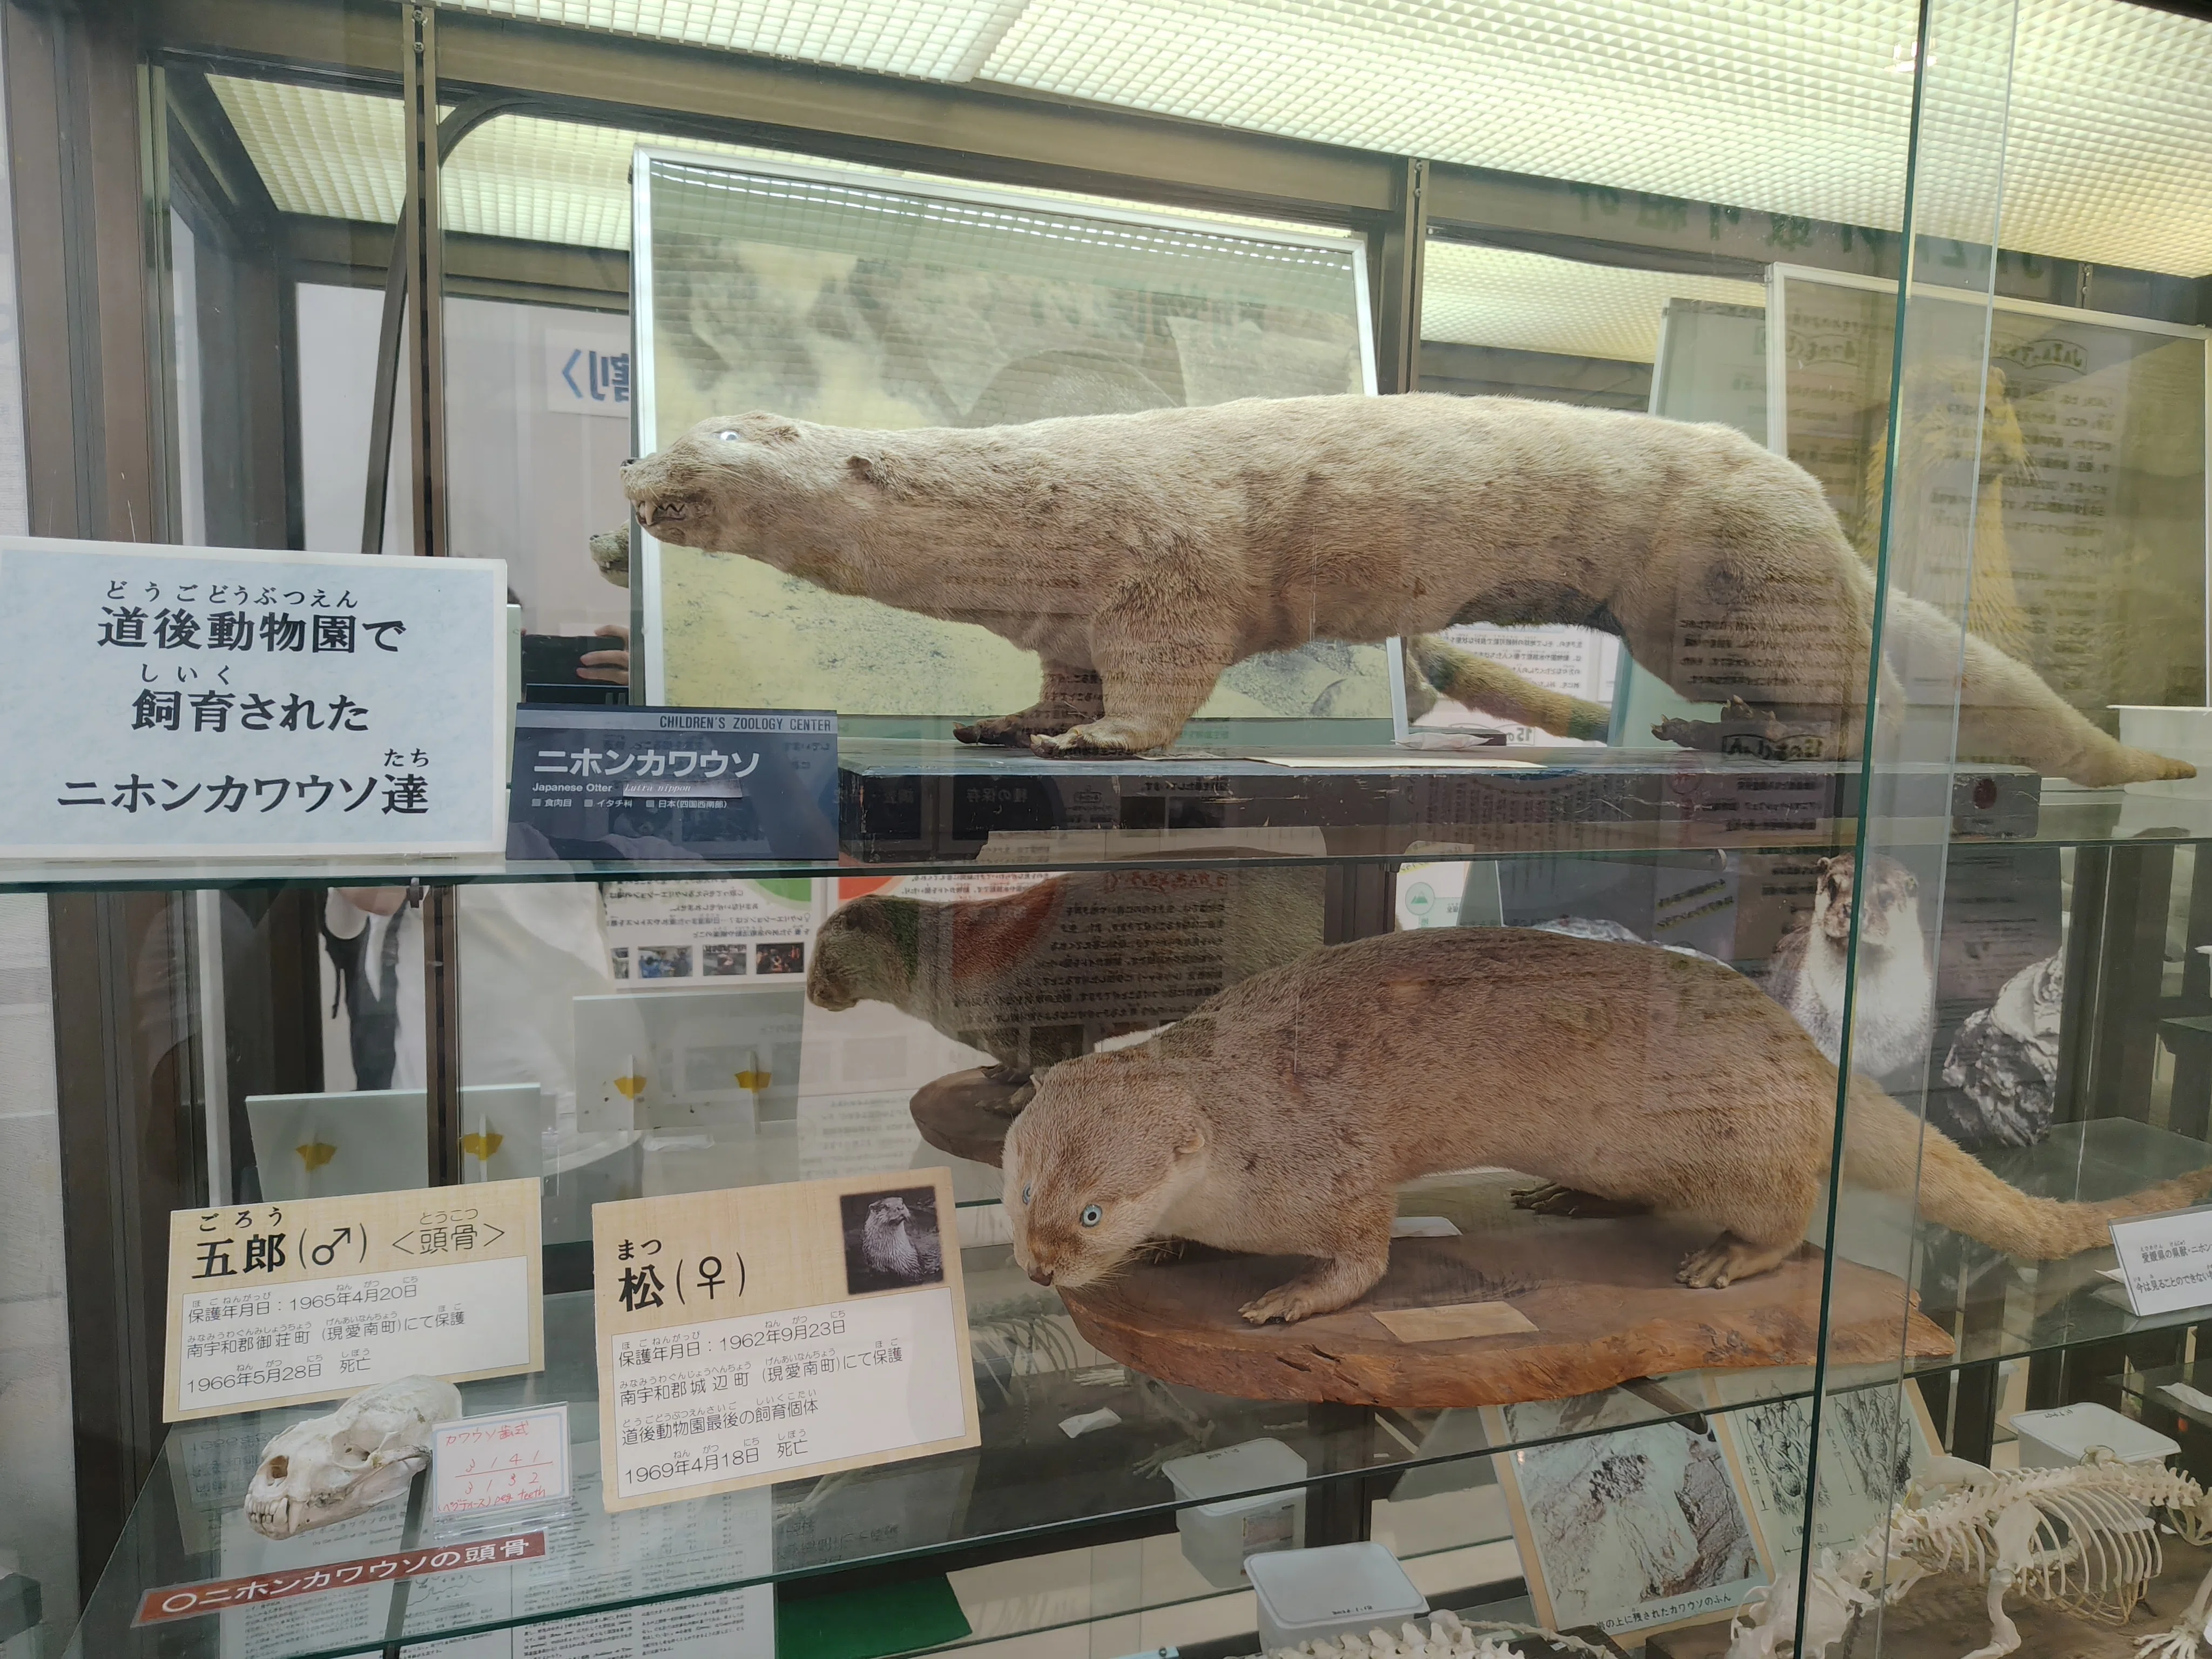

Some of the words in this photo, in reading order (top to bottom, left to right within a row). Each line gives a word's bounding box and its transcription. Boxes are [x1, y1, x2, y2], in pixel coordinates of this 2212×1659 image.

[96, 606, 408, 653] 道後動物園で
[140, 664, 233, 686] しいく
[131, 690, 369, 733] 飼育された
[659, 716, 726, 730] CHILDREN'S
[733, 717, 783, 731] ZOOLOGY
[790, 718, 831, 732] CENTER
[384, 747, 430, 767] たち
[534, 748, 760, 779] ニホンカワウソ
[57, 773, 430, 815] ニホンカワウソ達
[532, 783, 583, 793] Japanese
[586, 783, 613, 792] Otter
[658, 784, 691, 793] nippon
[544, 799, 572, 807] 食肉目
[597, 799, 632, 808] イタチ科
[200, 1207, 282, 1231] ごろう
[420, 1209, 478, 1225] とうこつ
[618, 1238, 662, 1261] まつ
[2141, 1243, 2212, 1264] 愛媛県の県獣・ニホン
[187, 1363, 322, 1394] 1966年5月28日
[340, 1358, 370, 1374] 死亡
[622, 1399, 819, 1445] 道後動物園最後の飼育個体
[509, 1453, 522, 1465] 4
[625, 1446, 760, 1485] 1969年4月18日
[776, 1440, 809, 1458] 死亡
[529, 1472, 539, 1484] 2
[517, 1485, 546, 1500] teeth
